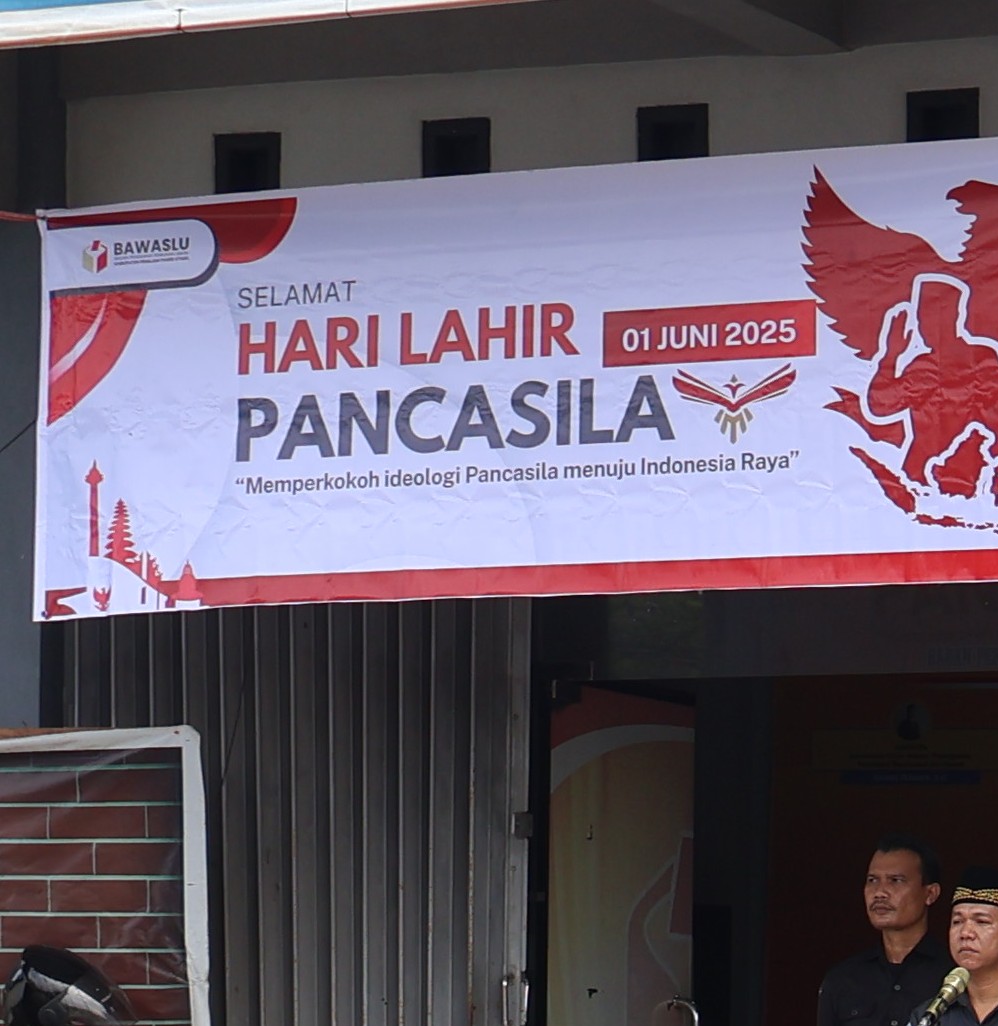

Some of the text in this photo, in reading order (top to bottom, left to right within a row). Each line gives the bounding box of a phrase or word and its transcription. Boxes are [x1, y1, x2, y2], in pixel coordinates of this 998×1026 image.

[114, 237, 190, 255] BAWASLU
[237, 280, 357, 309] SELAMAT
[237, 302, 580, 375] HARI LAHIR
[622, 318, 797, 352] 01 JUNI 2025
[235, 374, 676, 463] PANCASILA
[234, 449, 800, 496] “Memperkokoh ideologi Pancasila menuju Indonesia Raya”
